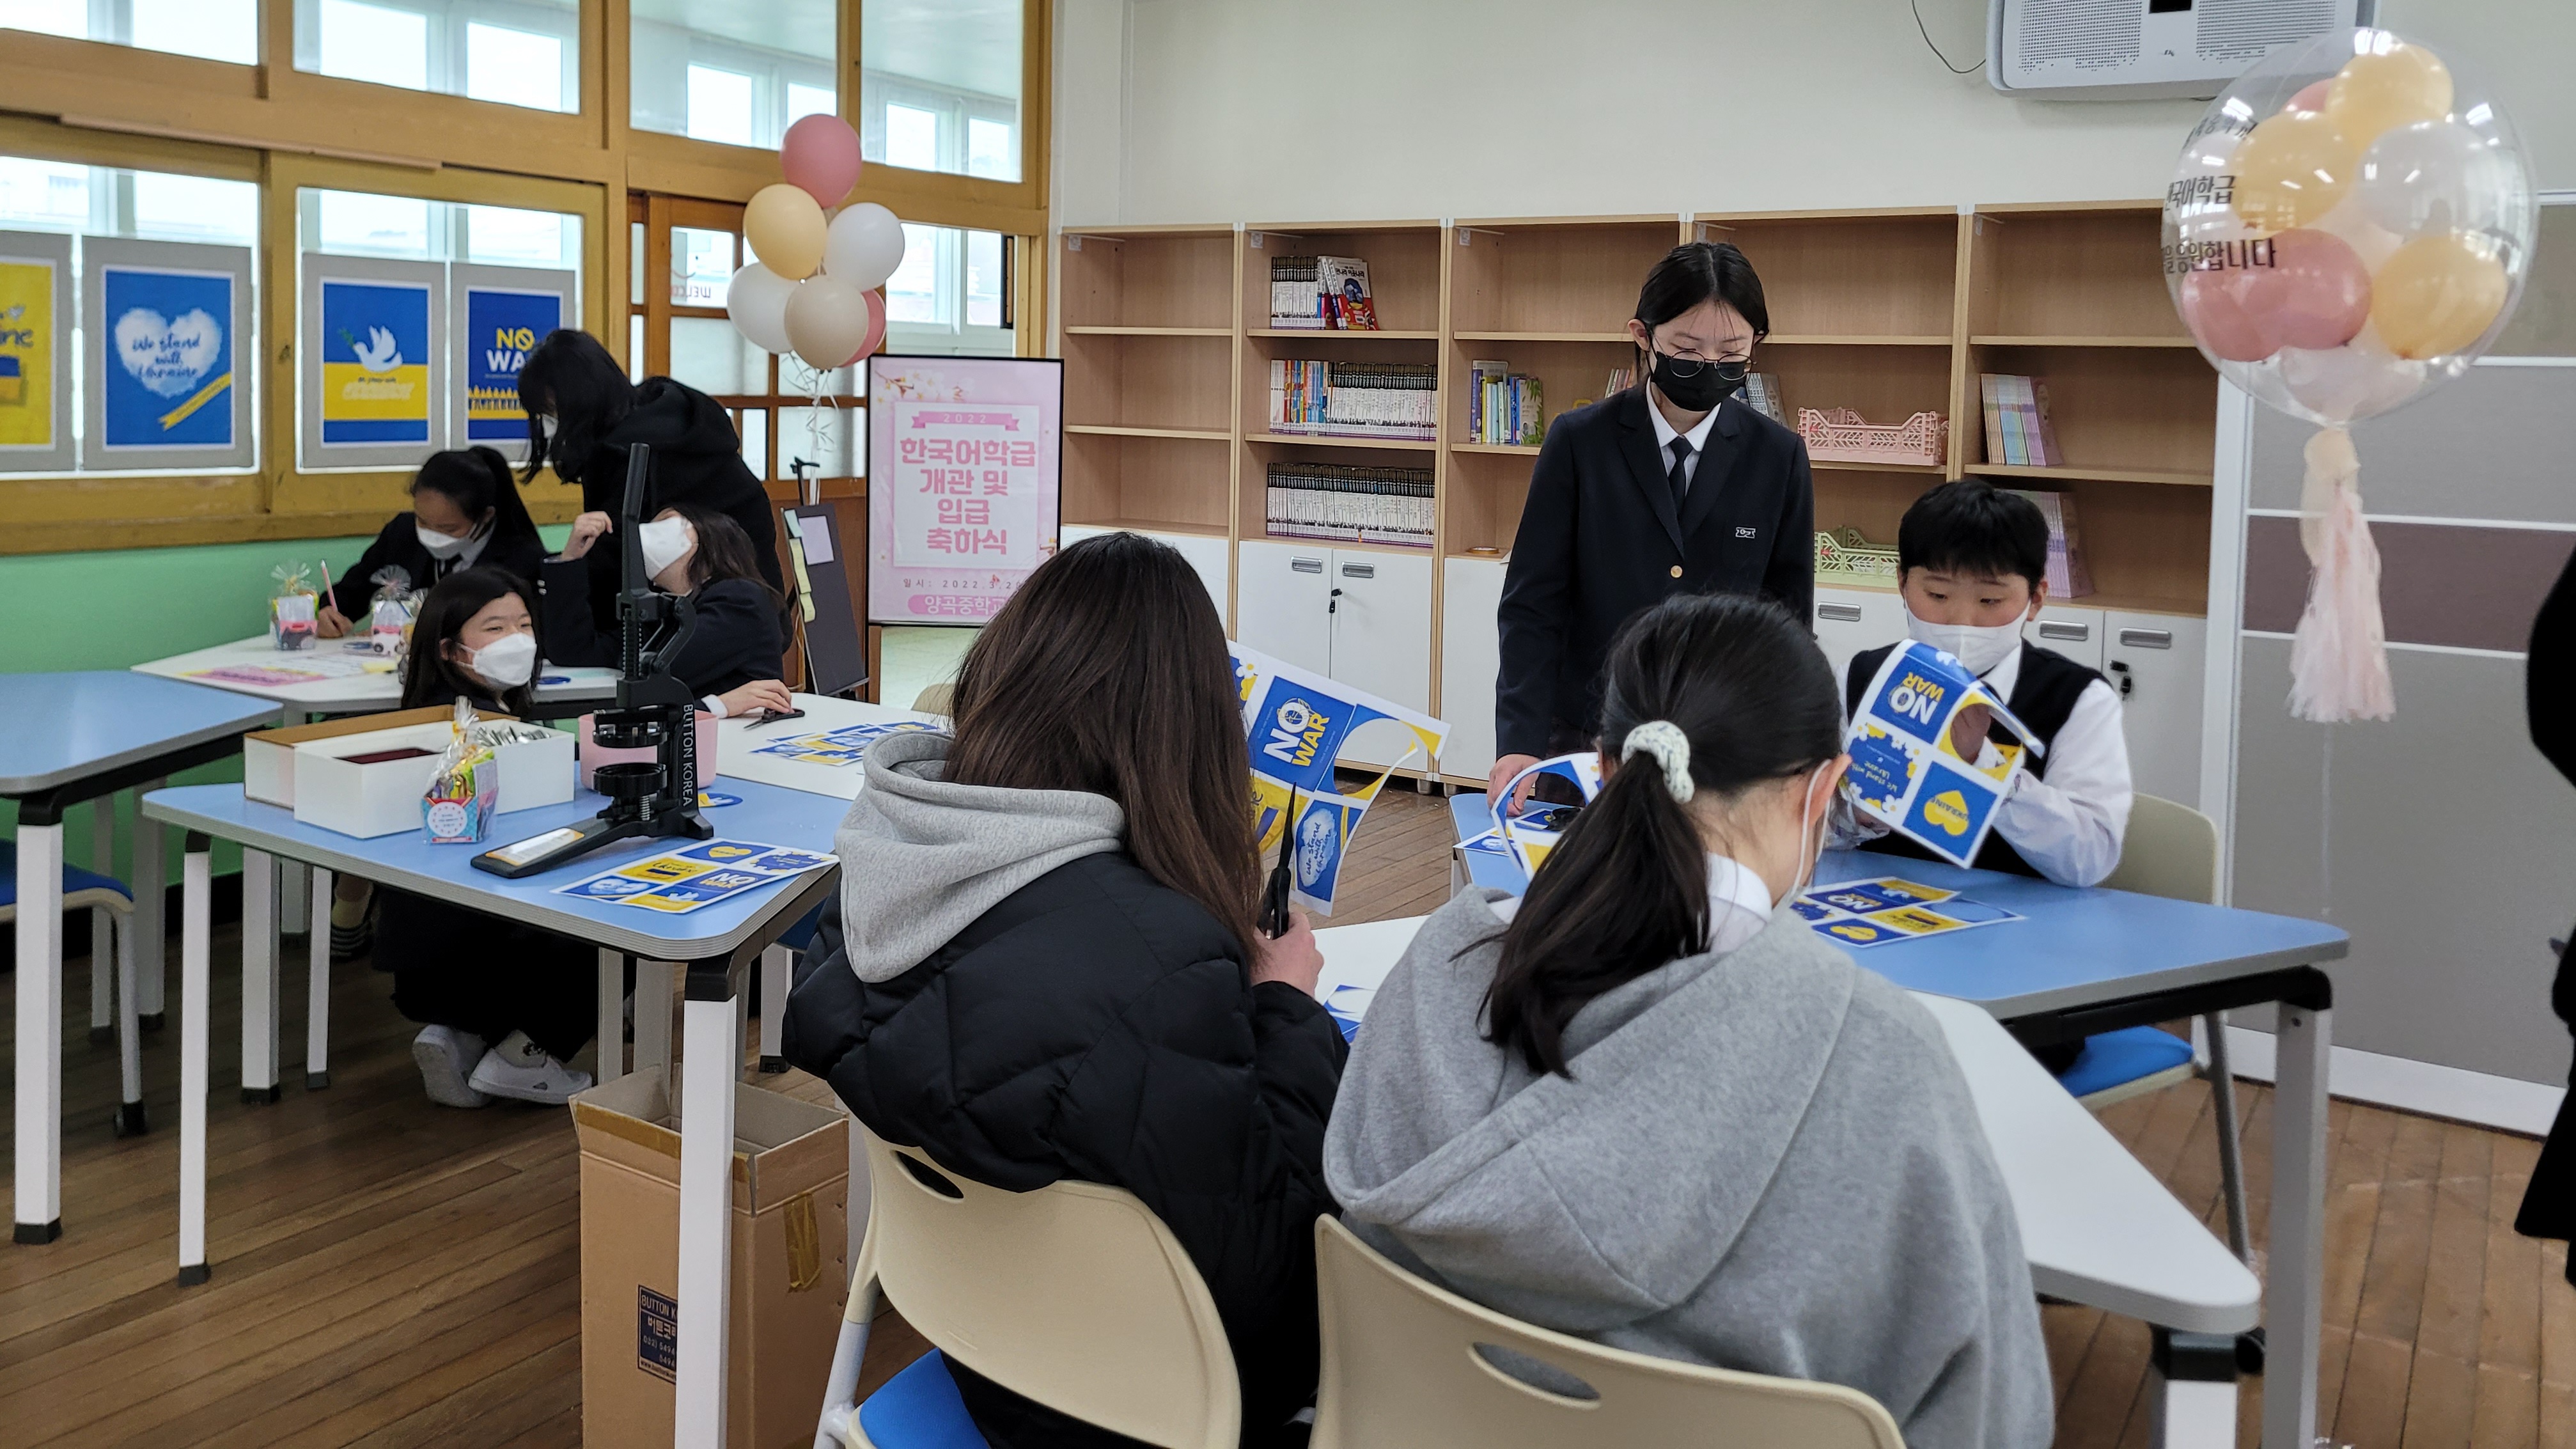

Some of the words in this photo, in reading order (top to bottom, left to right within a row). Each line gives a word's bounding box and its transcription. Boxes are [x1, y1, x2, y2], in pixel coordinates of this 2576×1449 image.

[159, 331, 201, 351] stand
[496, 327, 535, 352] NO
[486, 349, 526, 373] WA
[943, 413, 986, 425] 2022
[900, 437, 1036, 467] 한국어학급
[919, 468, 975, 495] 개관
[983, 470, 1009, 496] 및
[937, 498, 990, 525] 입급
[927, 527, 1007, 555] 축하식
[1903, 671, 1945, 702] WAR
[1890, 685, 1937, 725] NO
[683, 704, 694, 758] BUTTON
[1263, 700, 1312, 763] NO
[1292, 712, 1331, 767] WAR
[683, 762, 694, 807] KOREA
[1307, 822, 1322, 854] stand
[1314, 838, 1323, 859] with
[709, 872, 756, 884] NO
[642, 1296, 669, 1316] BUTTON
